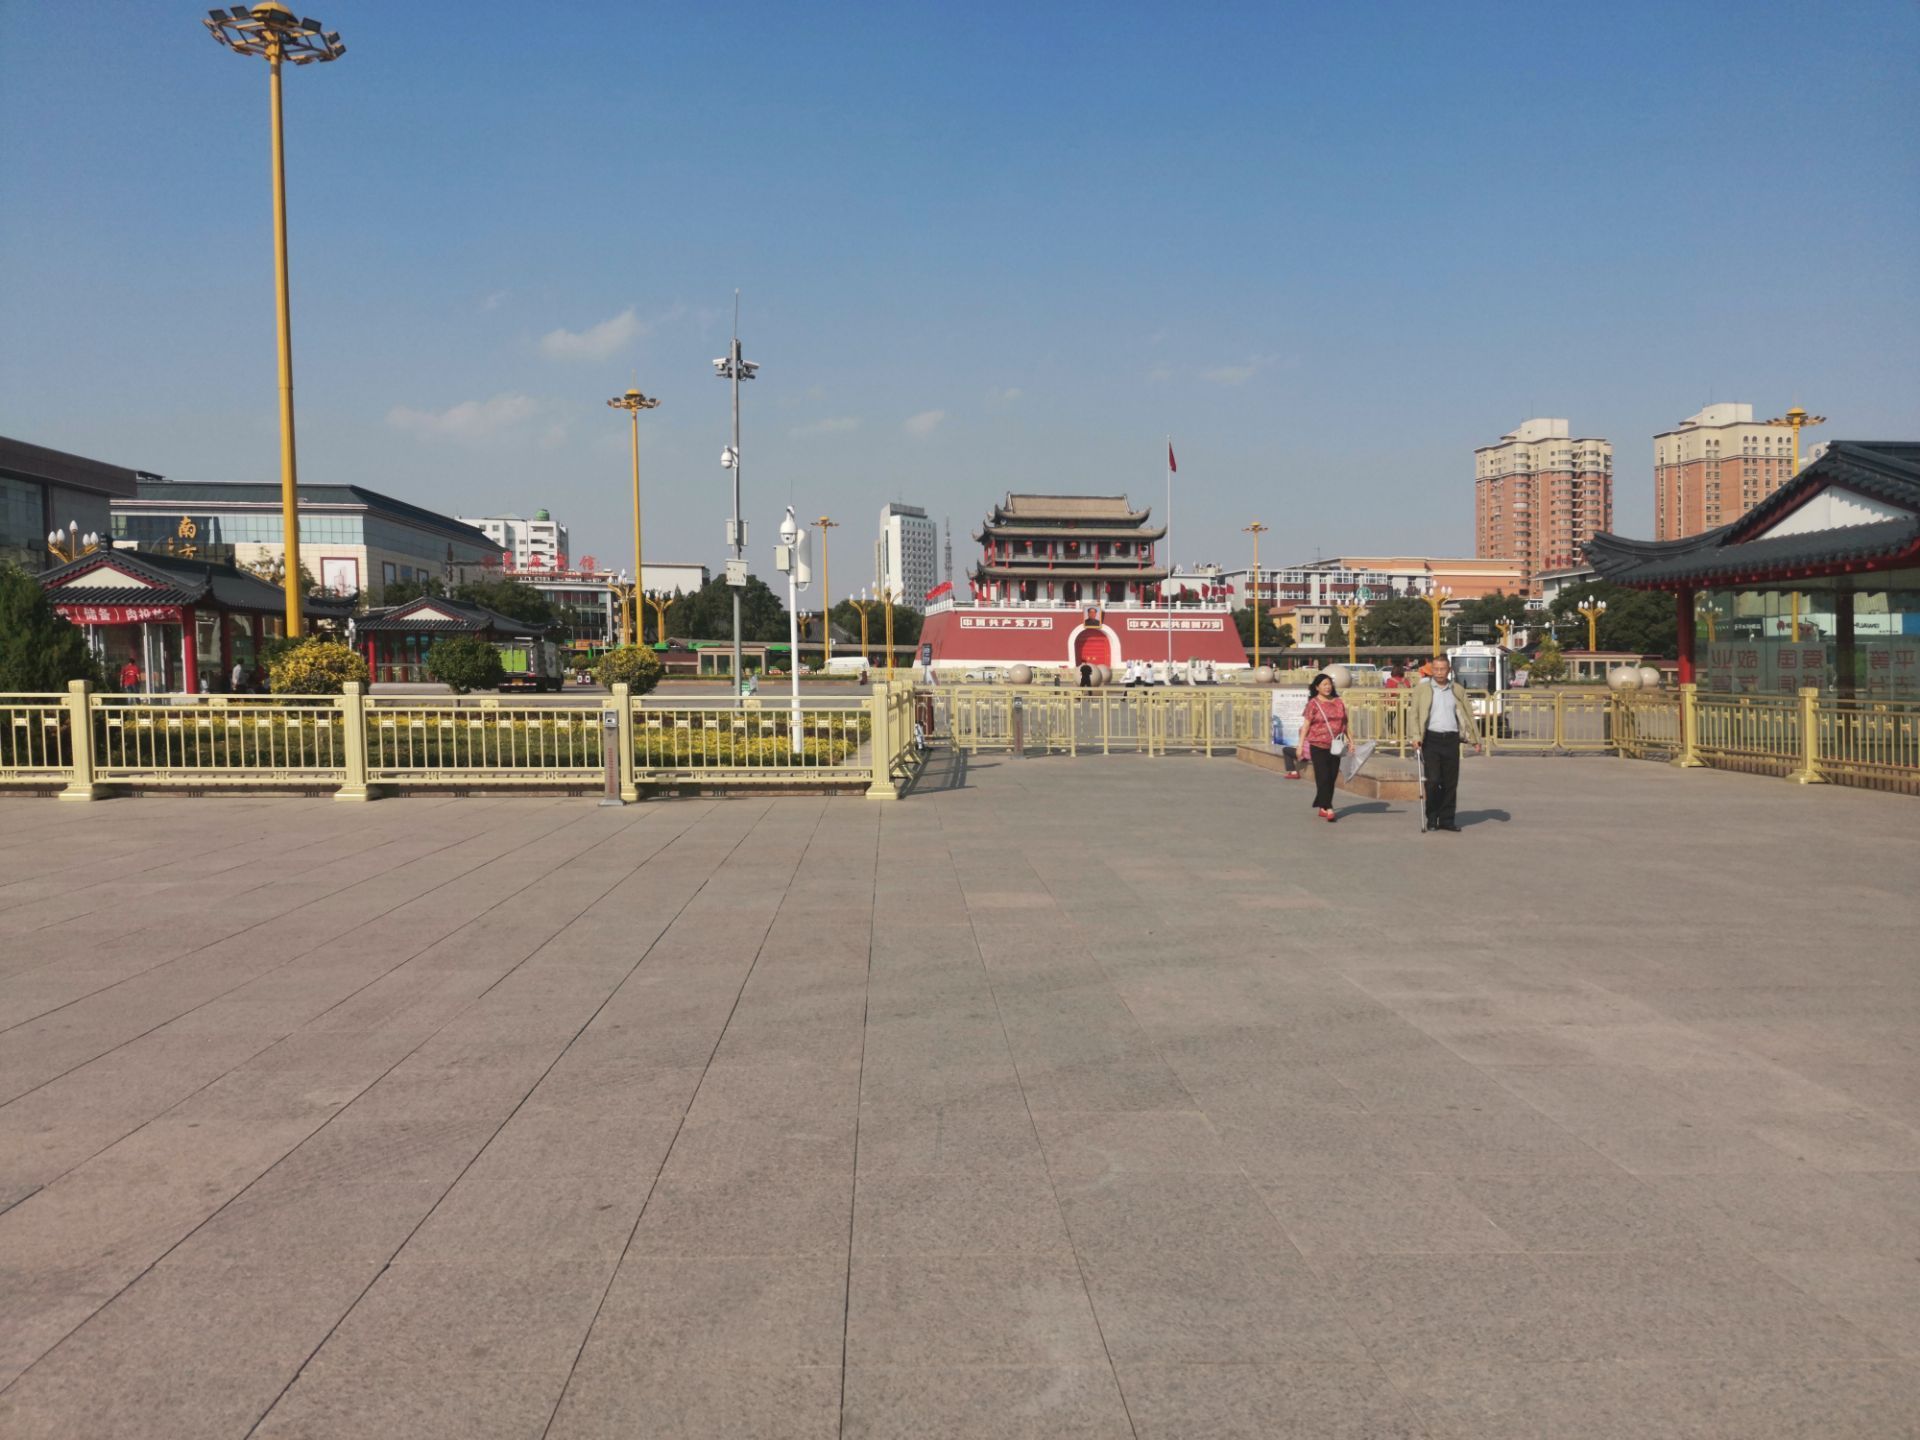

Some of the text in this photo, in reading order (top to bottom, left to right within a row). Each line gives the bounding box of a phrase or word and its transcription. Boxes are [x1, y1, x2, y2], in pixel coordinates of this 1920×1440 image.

[962, 618, 1051, 628] 中国共产党万岁
[1129, 620, 1221, 629] 中华人民共和国万岁
